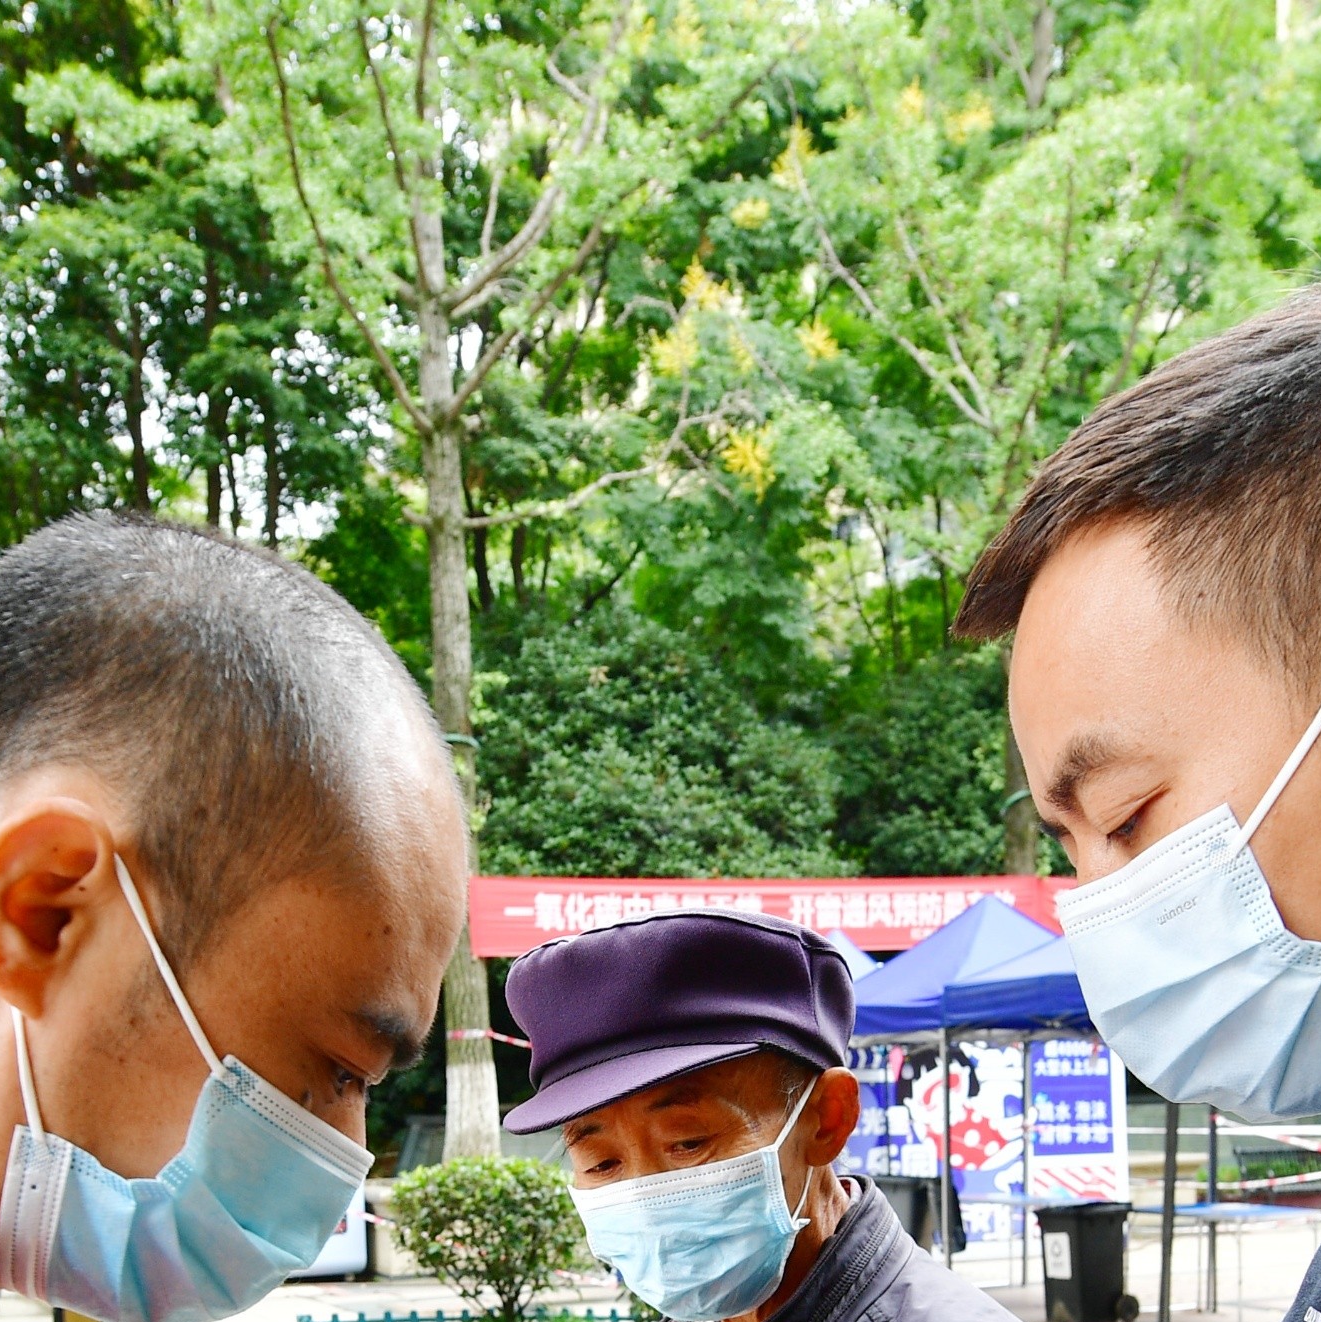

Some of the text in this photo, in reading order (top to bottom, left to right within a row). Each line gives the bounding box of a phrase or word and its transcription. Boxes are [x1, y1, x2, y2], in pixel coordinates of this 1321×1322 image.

[789, 890, 1016, 928] 开窗通风预防最
